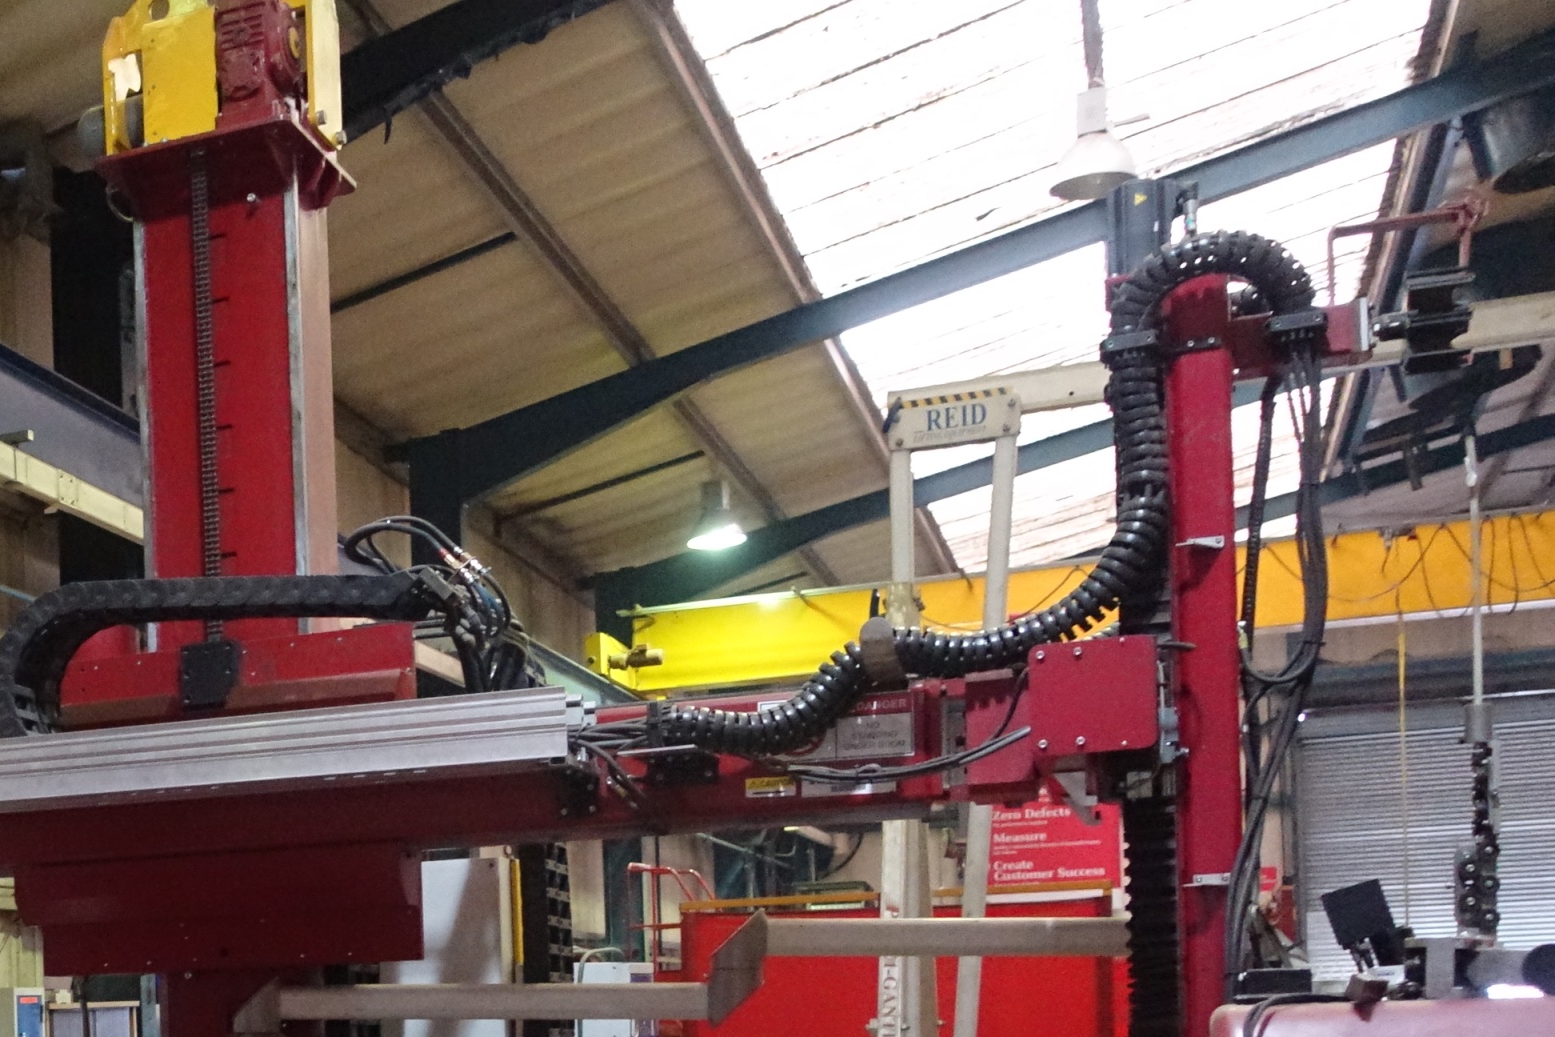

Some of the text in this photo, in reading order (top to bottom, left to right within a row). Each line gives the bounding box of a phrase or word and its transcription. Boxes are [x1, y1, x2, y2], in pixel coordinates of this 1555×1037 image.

[925, 403, 987, 431] REID
[992, 806, 1071, 821] Zero Defects
[993, 832, 1047, 843] Measure
[993, 860, 1034, 871] Create
[993, 866, 1106, 881] Customer Success
